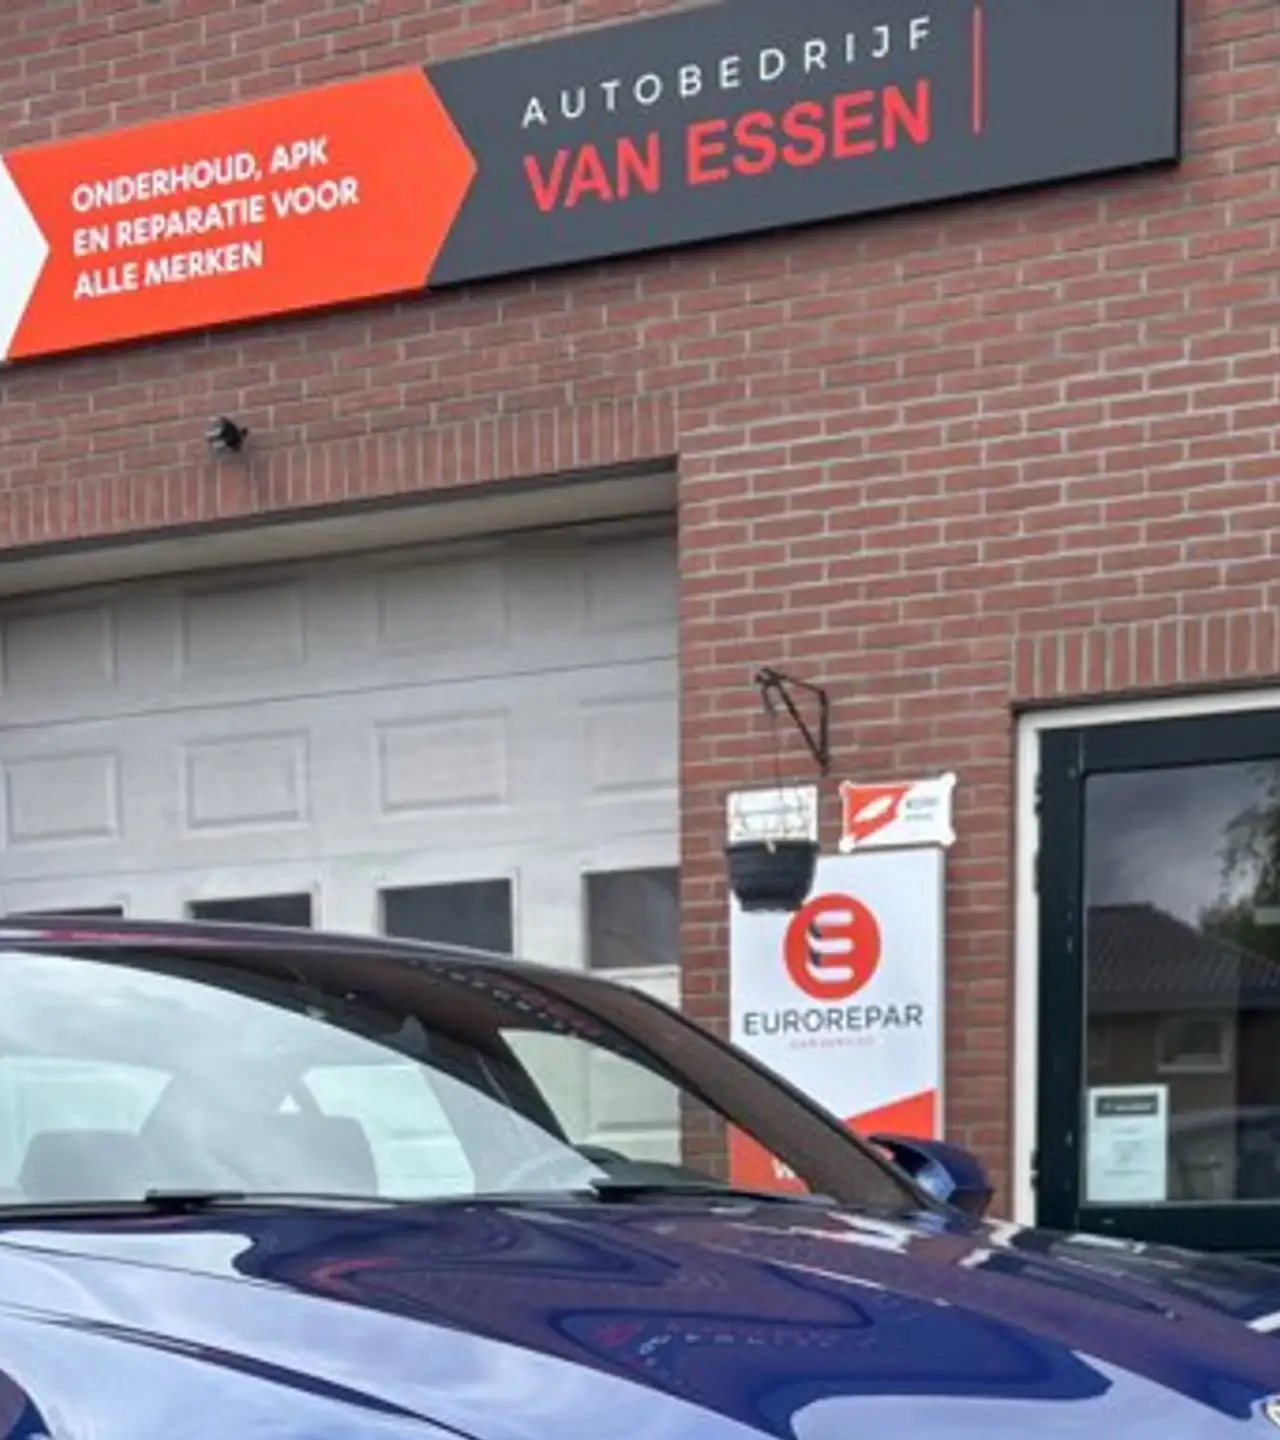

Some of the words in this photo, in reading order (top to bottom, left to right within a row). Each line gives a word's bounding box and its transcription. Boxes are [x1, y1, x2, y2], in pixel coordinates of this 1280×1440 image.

[521, 16, 931, 129] AUTOBEDRIJF
[72, 152, 263, 213] ONDERHOUD,
[271, 136, 329, 174] APK
[523, 130, 662, 213] VAN
[685, 78, 933, 186] ESSEN
[73, 224, 109, 257] EN
[116, 195, 267, 248] REPARATIE
[272, 176, 361, 219] VOOR
[73, 261, 140, 300] ALLE
[144, 240, 264, 287] MERKEN
[742, 1004, 924, 1036] EUROREPAR
